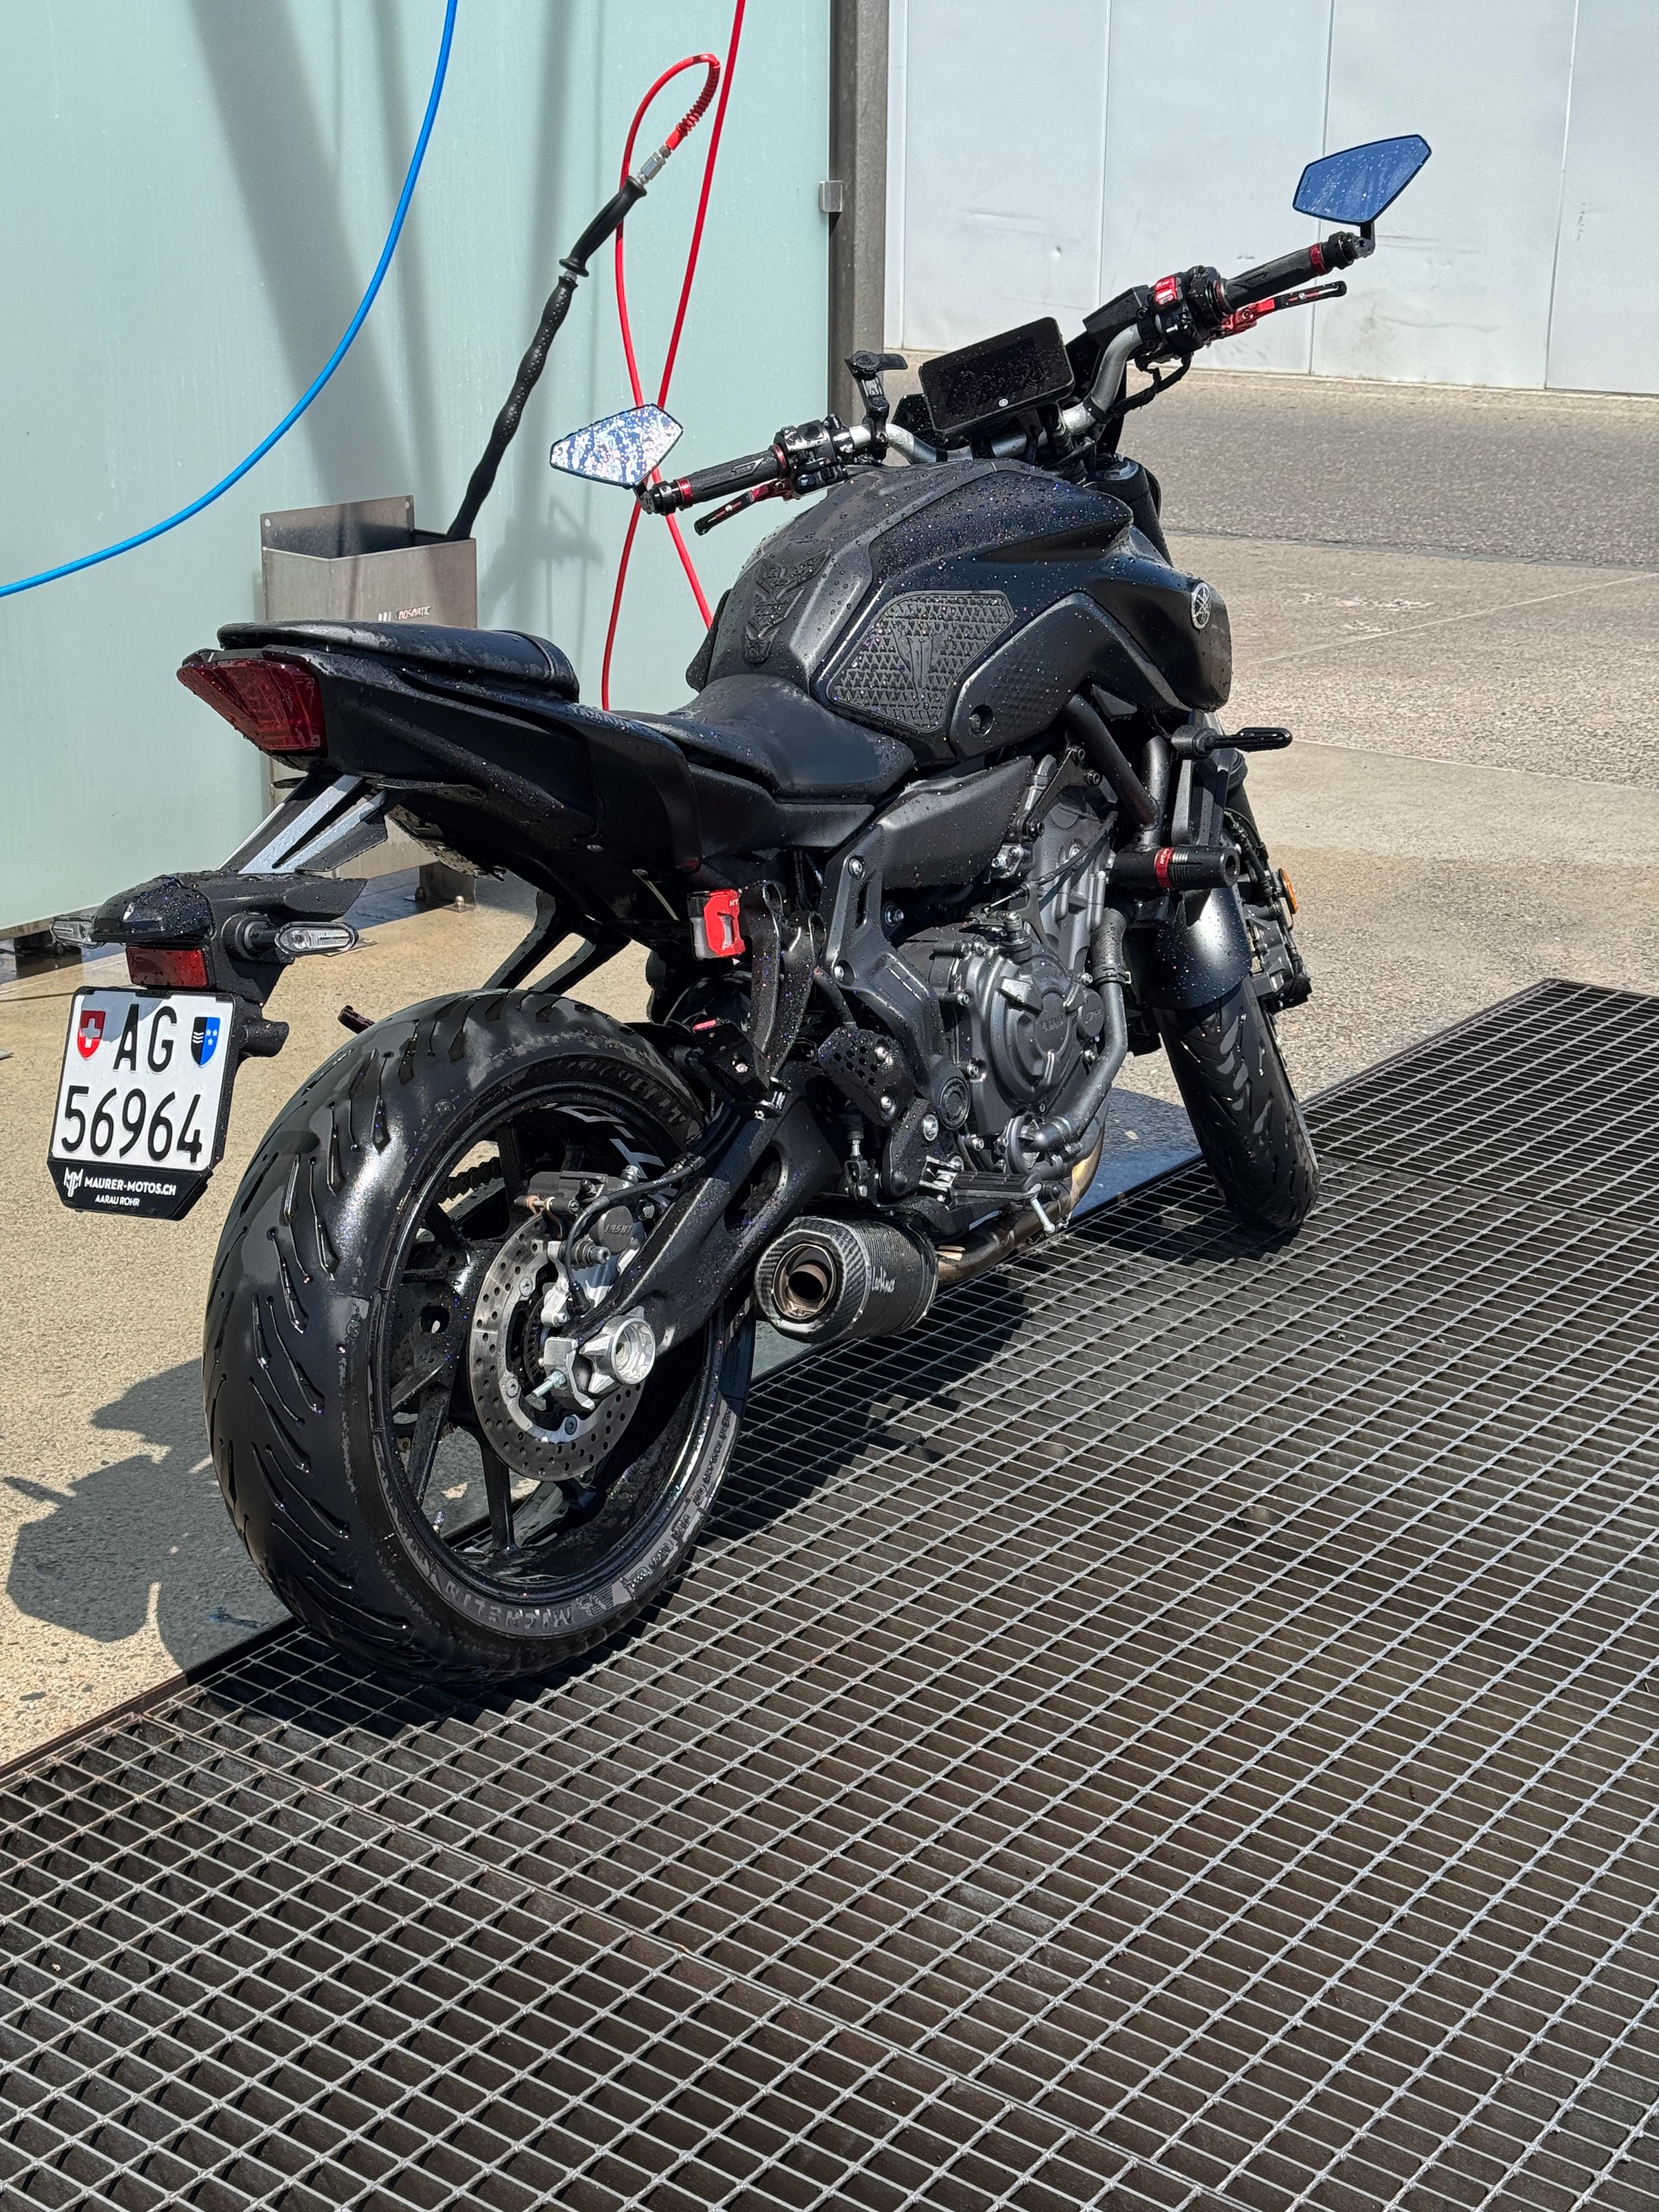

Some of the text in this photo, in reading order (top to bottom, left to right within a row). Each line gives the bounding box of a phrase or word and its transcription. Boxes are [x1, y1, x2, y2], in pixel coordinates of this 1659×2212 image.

[397, 605, 431, 620] MOSMATIC
[112, 1003, 178, 1073] AG
[60, 1084, 202, 1163] 56964
[83, 1176, 177, 1196] MAURER-MOTOS.CH
[94, 1194, 141, 1207] AARAU ROHR
[443, 1579, 574, 1630] MICHELIN
